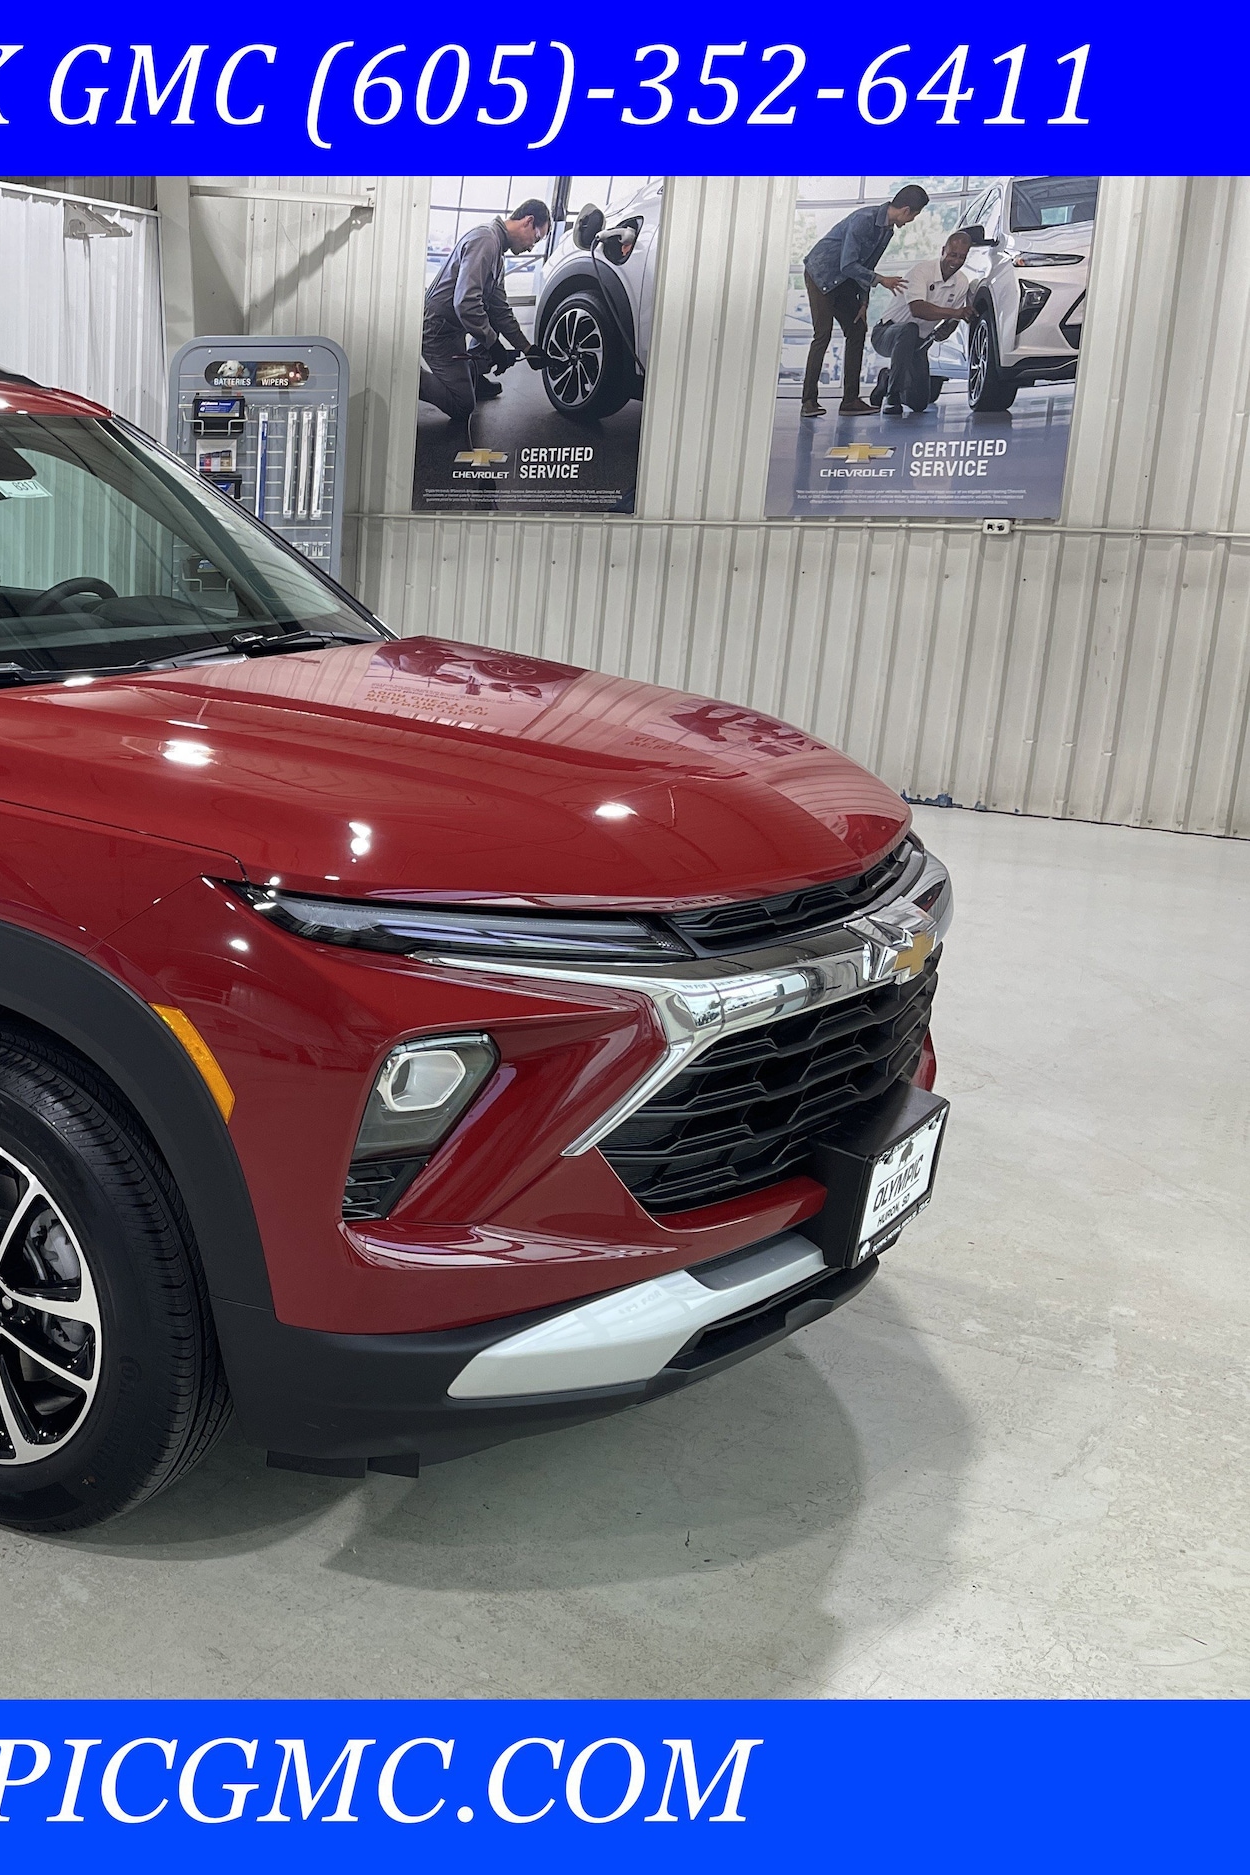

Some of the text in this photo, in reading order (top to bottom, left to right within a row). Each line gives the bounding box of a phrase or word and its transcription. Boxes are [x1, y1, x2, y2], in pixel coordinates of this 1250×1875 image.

[213, 377, 289, 386] BATTERIES WIPERS
[520, 446, 594, 462] CERTIFIED
[911, 439, 1007, 458] CERTIFIED
[452, 470, 510, 479] CHEVROLET
[519, 464, 580, 479] SERVICE
[819, 468, 896, 478] CHEVROLET
[909, 460, 989, 477] SERVICE
[872, 1154, 924, 1213] OLYMPIC
